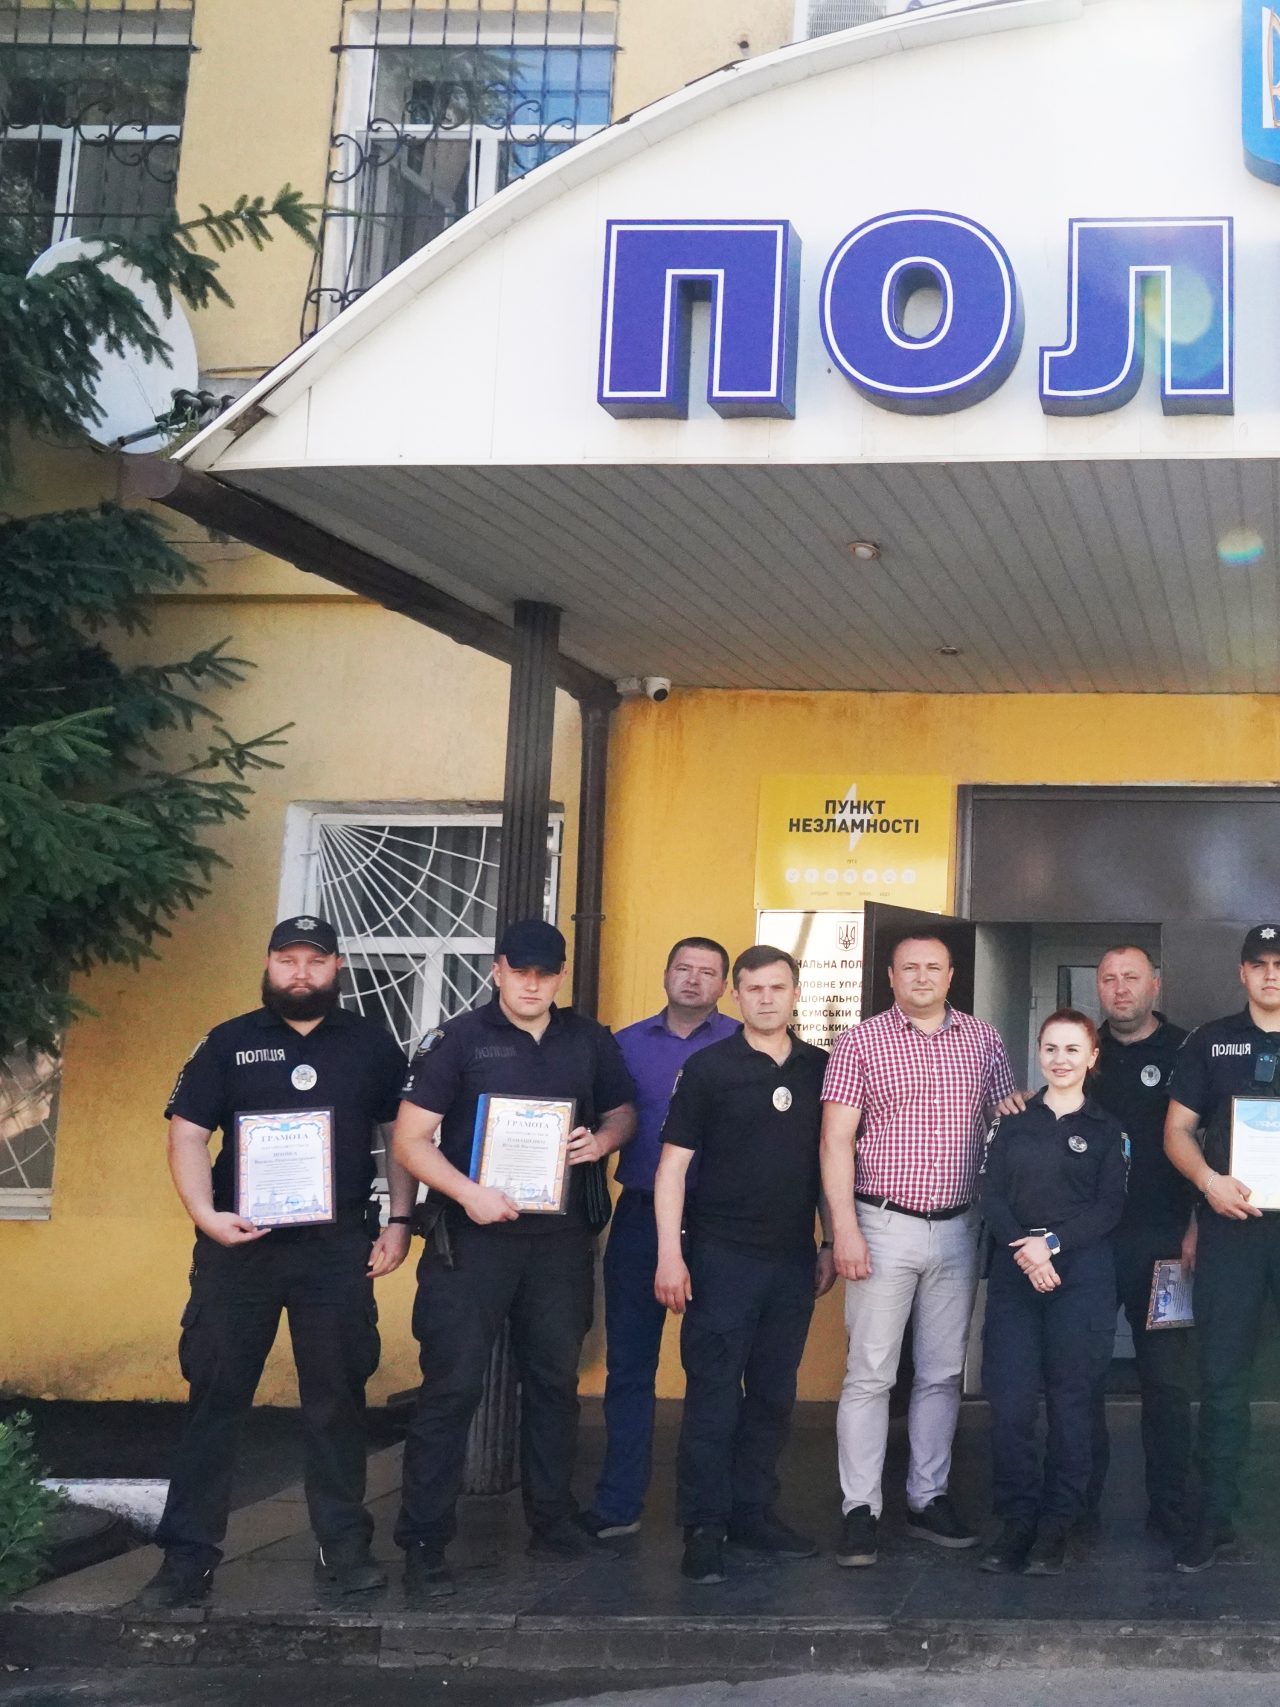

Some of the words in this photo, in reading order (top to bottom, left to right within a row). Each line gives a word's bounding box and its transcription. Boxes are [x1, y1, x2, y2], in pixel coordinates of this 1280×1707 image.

[825, 799, 886, 814] ПУНКТ
[788, 818, 920, 834] НЕЗЛАМНОСТІ
[799, 994, 859, 1003] ЦІОНАЛЬНО
[235, 1048, 286, 1066] ПОЛІЦІЯ
[1211, 1043, 1252, 1057] ПОЛІЦІЯ
